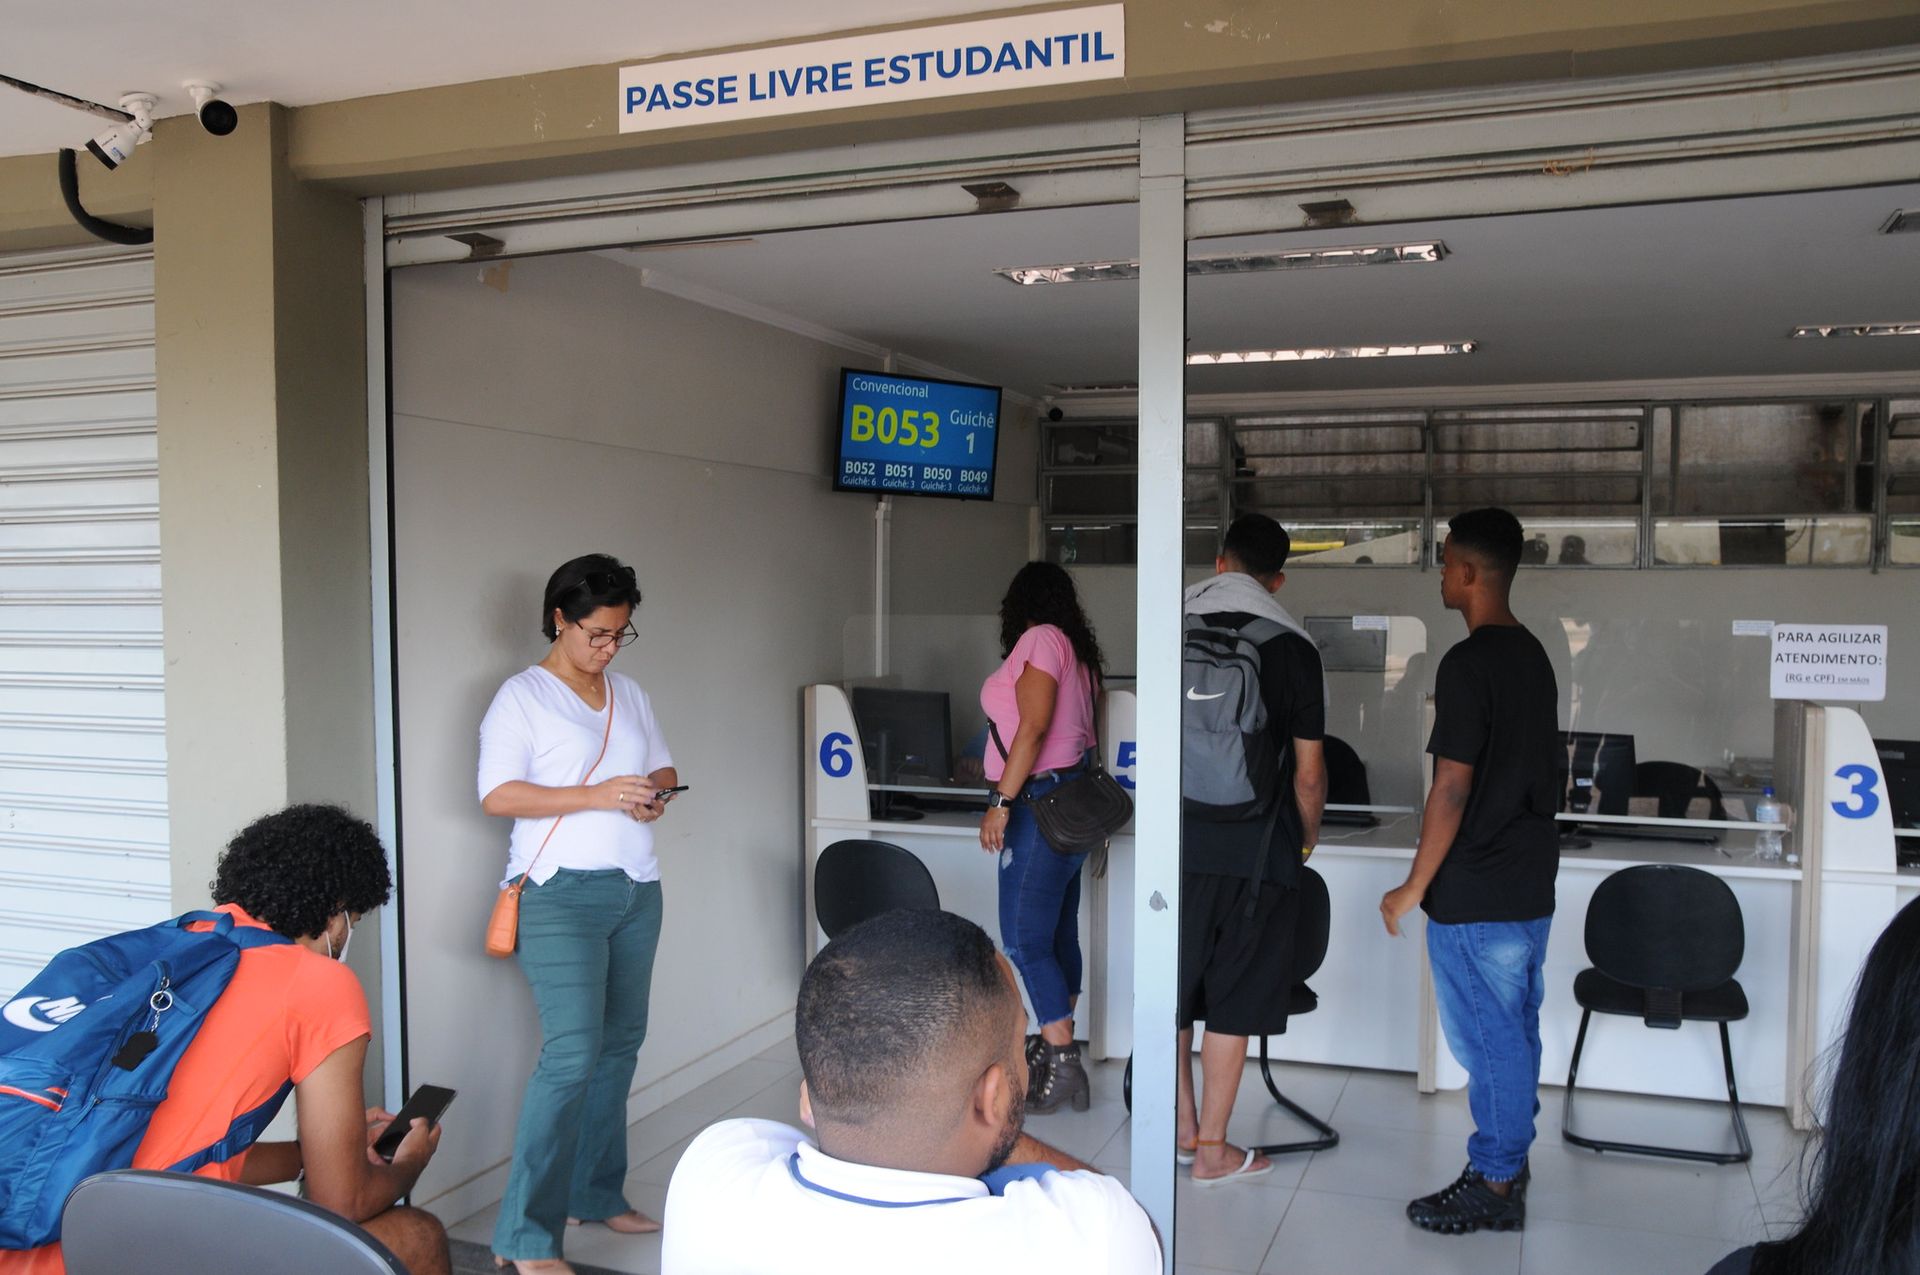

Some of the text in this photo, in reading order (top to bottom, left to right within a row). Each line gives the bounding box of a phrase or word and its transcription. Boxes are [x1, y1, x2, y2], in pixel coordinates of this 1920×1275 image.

[626, 30, 1115, 115] PASSE LIVRE ESTUDANTIL
[852, 377, 929, 398] Convencional
[851, 404, 940, 448] B053
[950, 409, 995, 429] Guichê
[965, 432, 975, 454] 1
[845, 461, 875, 475] B052
[885, 464, 913, 478] B051
[923, 467, 952, 481] B050
[960, 470, 988, 484] B049
[1777, 632, 1881, 644] PARA AGILIZAR
[1775, 652, 1882, 665] ATENDIMENTO:
[819, 731, 853, 778] 6
[1831, 764, 1880, 820] 3
